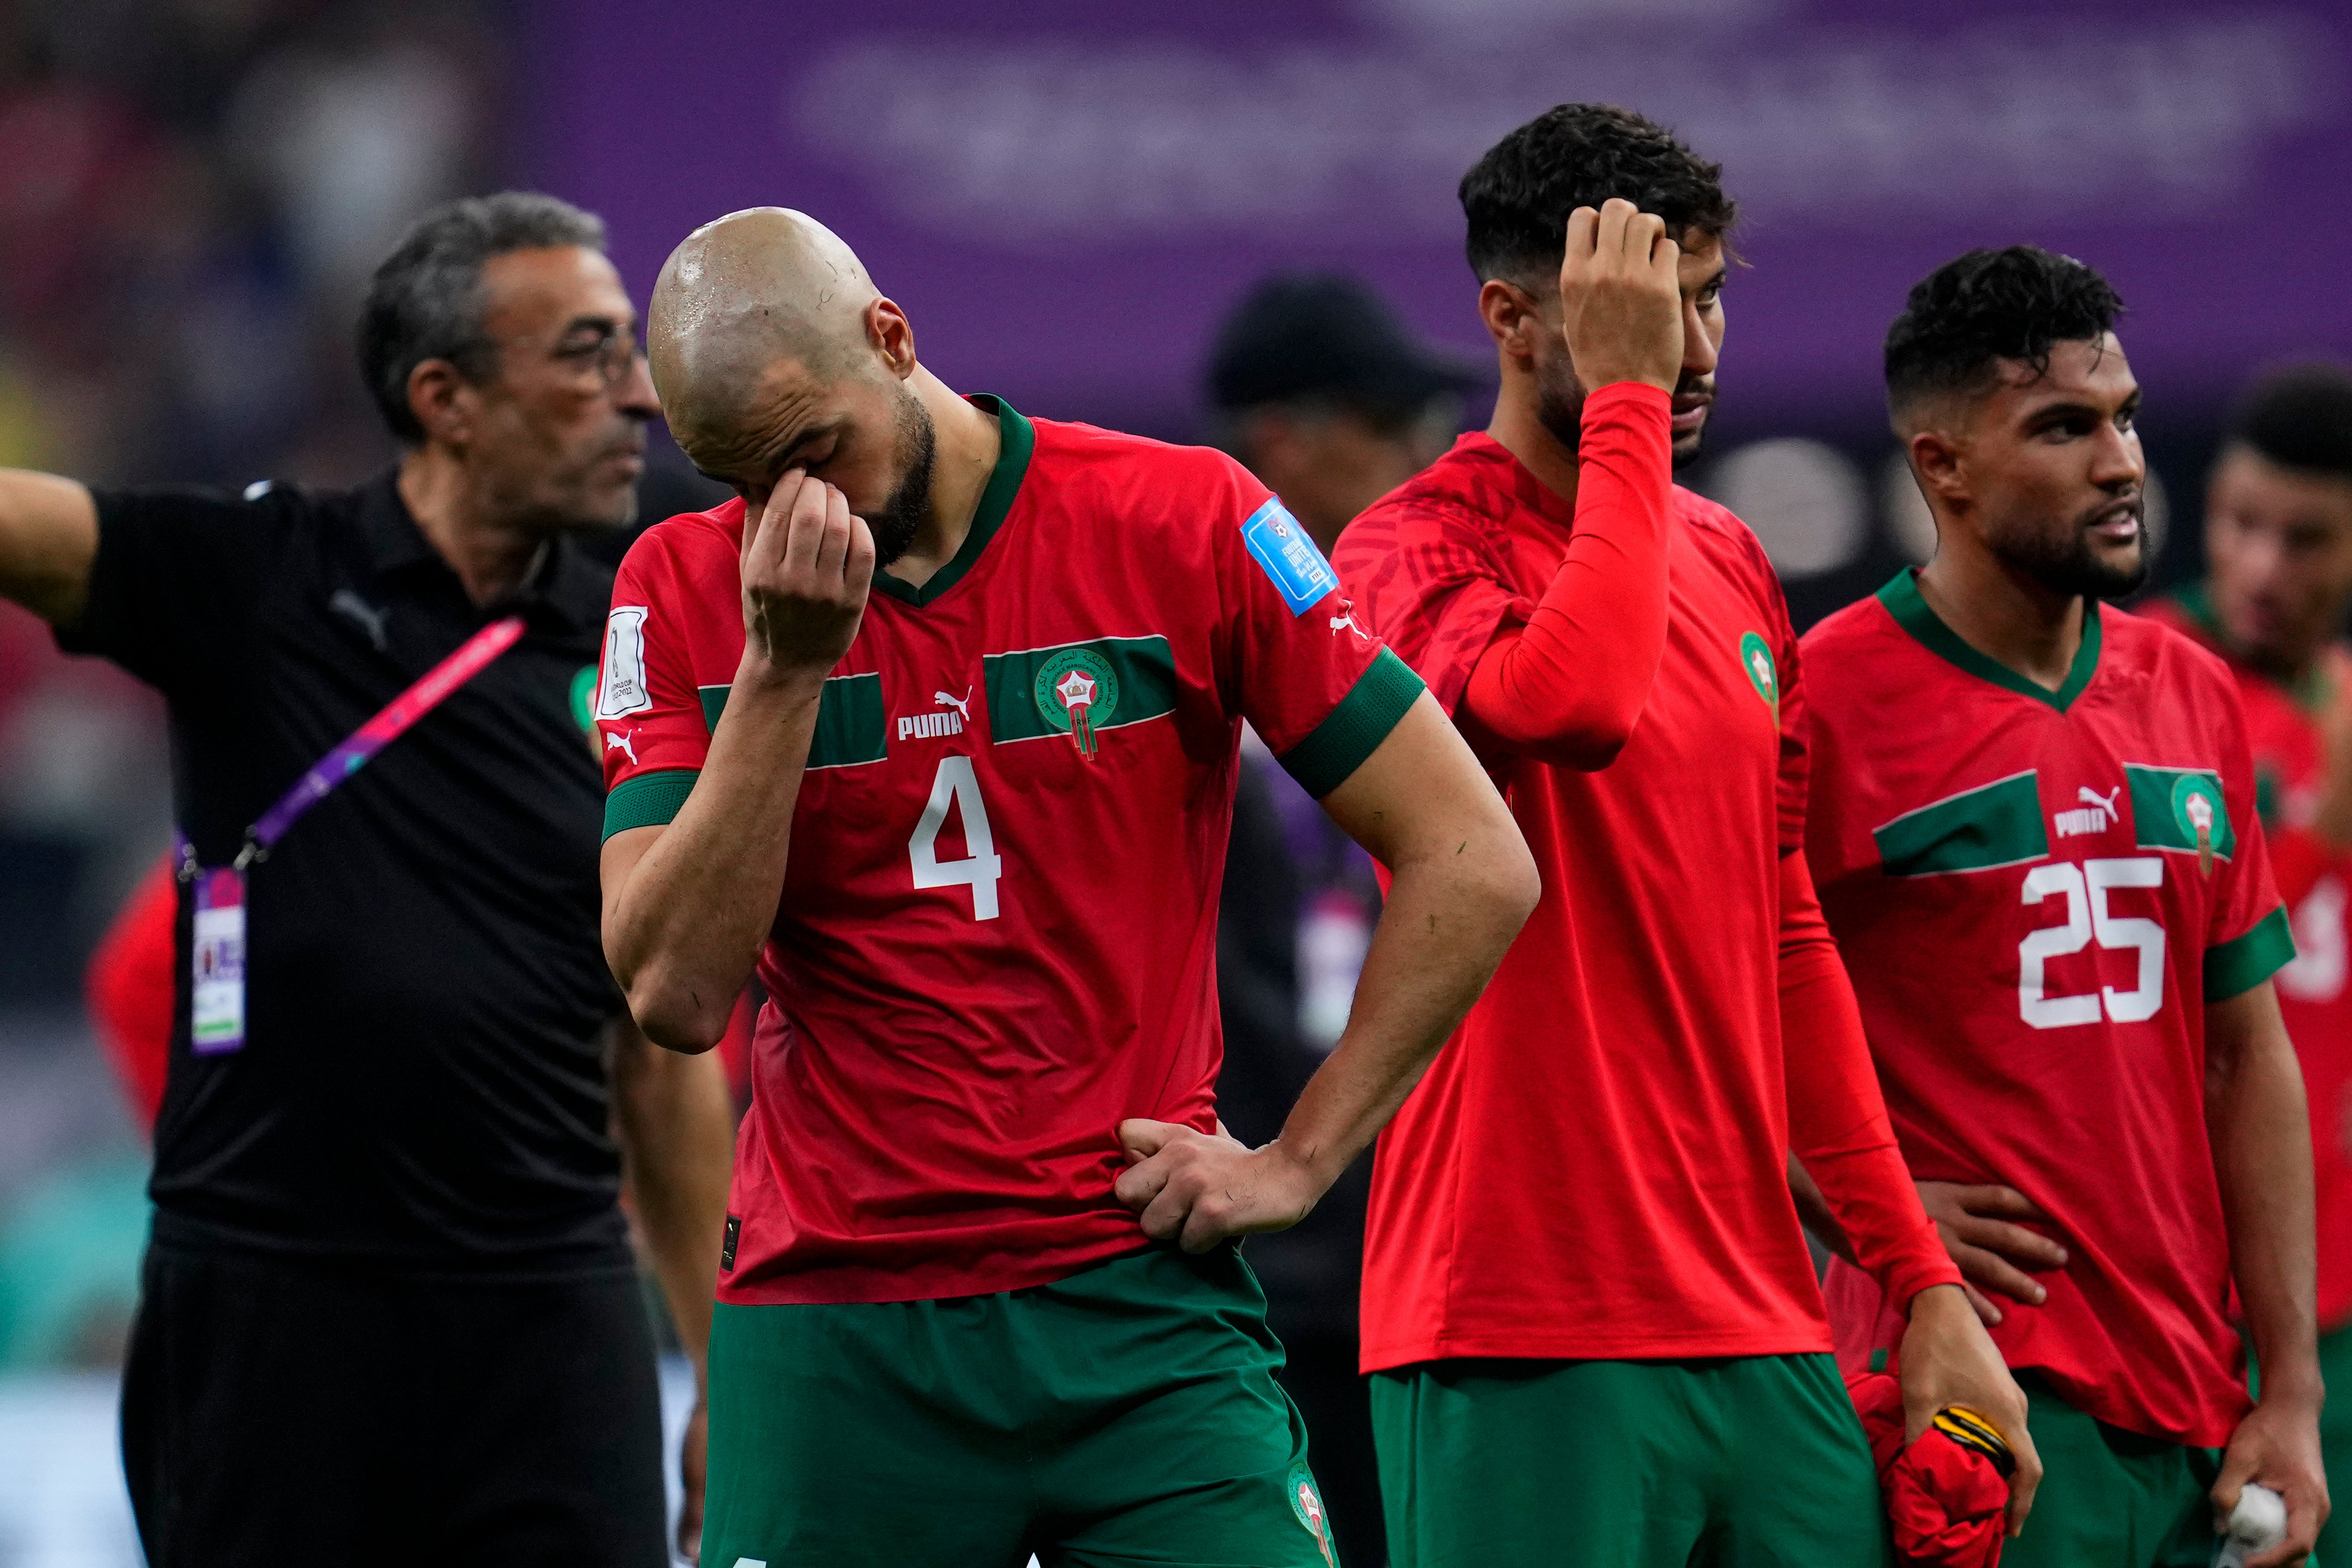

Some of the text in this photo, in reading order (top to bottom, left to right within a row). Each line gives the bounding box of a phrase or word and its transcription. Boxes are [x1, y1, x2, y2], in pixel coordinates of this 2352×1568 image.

[1312, 571, 1322, 580] FIFA
[1038, 651, 1116, 715] الجامعة الملكية المغربية لكرة القدم
[1052, 668, 1065, 685] ROYALE
[1066, 663, 1096, 677] MAROCAINE
[1093, 682, 1104, 710] FOOTBALL
[898, 711, 963, 741] PUMA
[909, 757, 1001, 920] 4
[2054, 808, 2107, 838] PUMA
[2019, 859, 2165, 1028] 25
